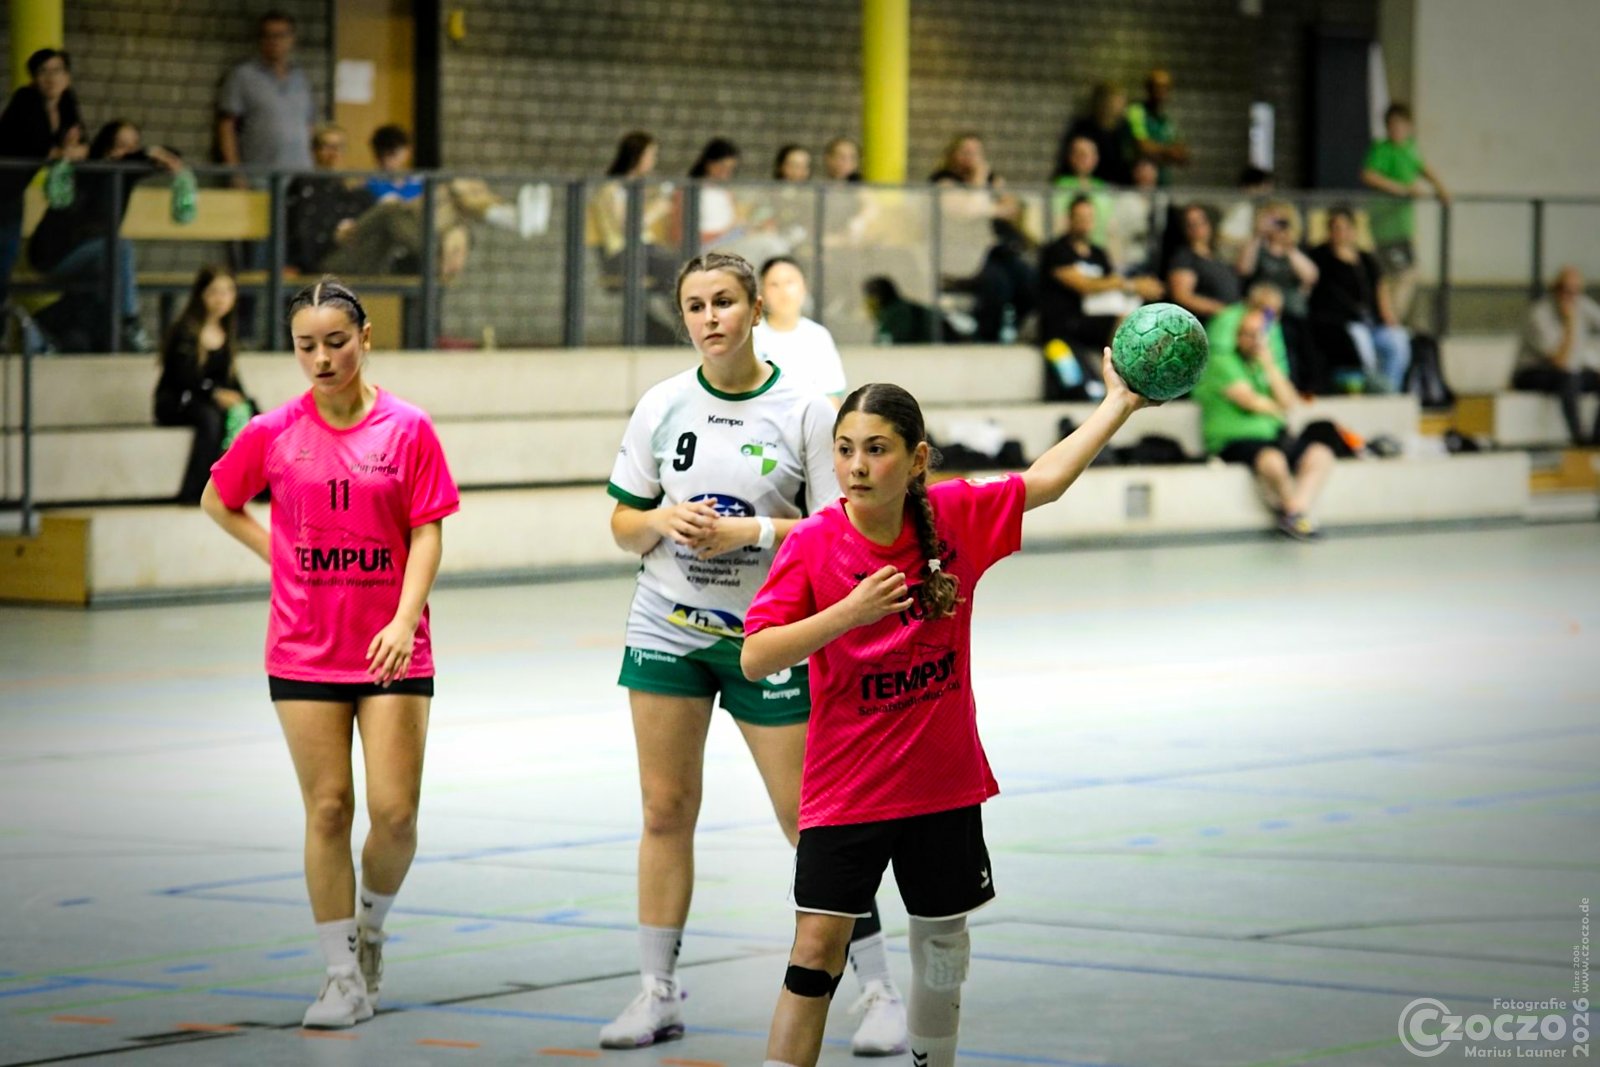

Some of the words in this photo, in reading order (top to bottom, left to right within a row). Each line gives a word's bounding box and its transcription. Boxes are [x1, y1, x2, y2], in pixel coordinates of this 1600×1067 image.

[672, 431, 698, 471] 9
[327, 478, 349, 511] 11
[711, 577, 741, 587] Krefeld
